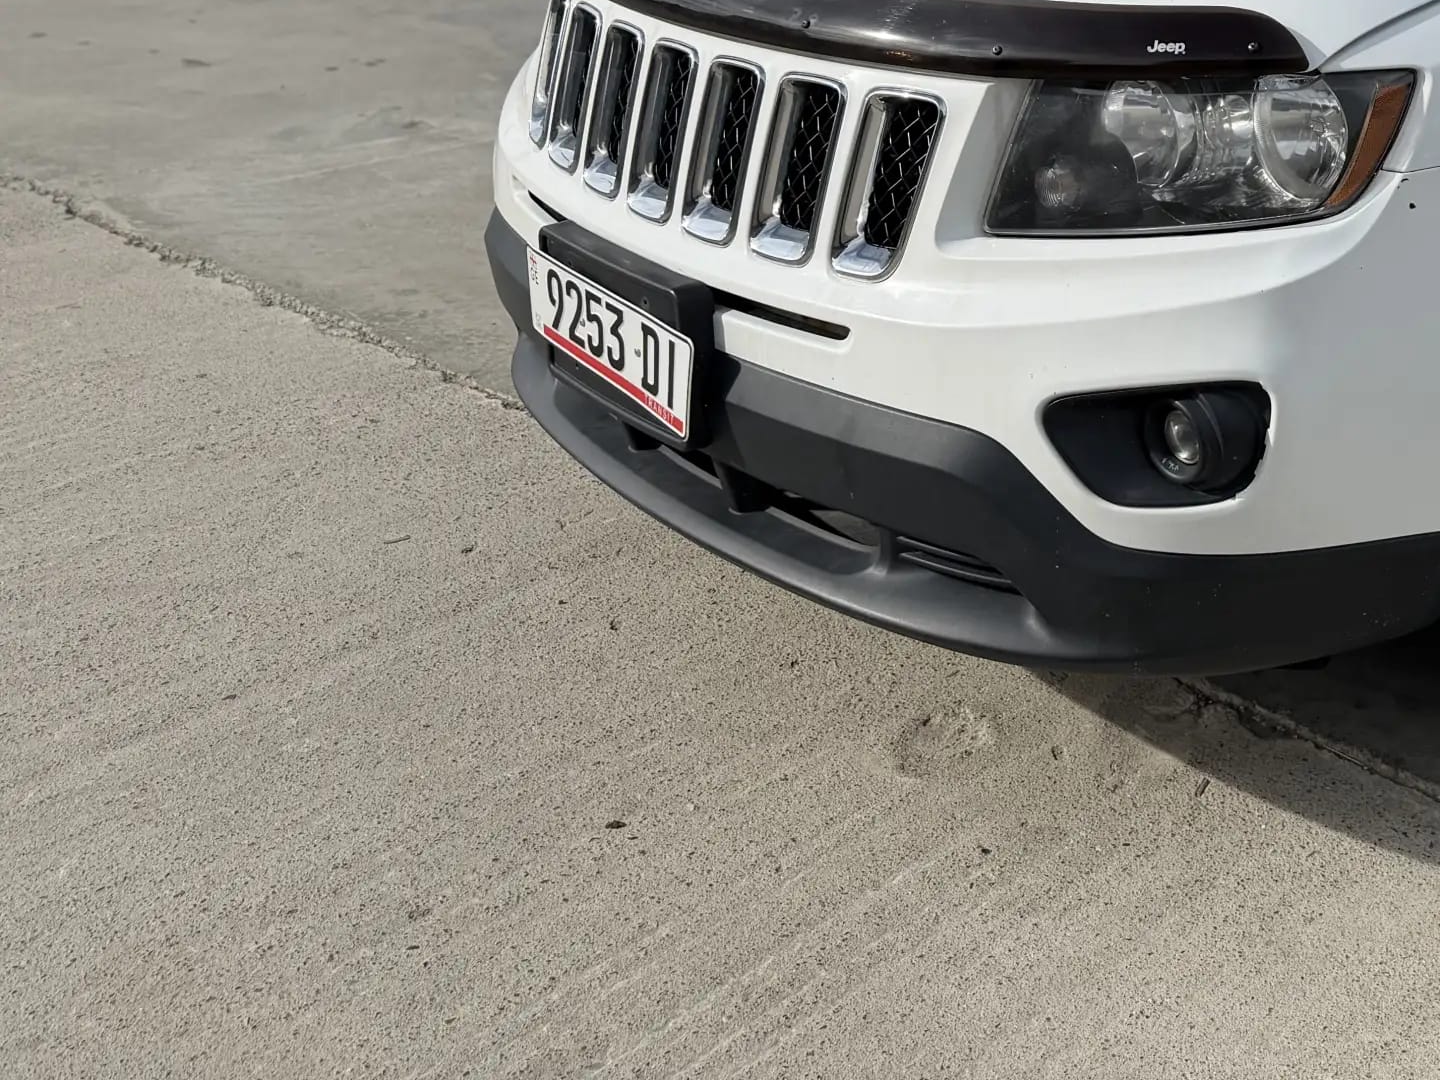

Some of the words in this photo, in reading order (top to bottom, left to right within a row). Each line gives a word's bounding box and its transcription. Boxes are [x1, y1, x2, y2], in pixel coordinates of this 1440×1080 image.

[1147, 40, 1186, 55] Jeep
[547, 268, 625, 371] 9253
[641, 322, 675, 410] DI
[644, 393, 674, 424] TRANSIT
